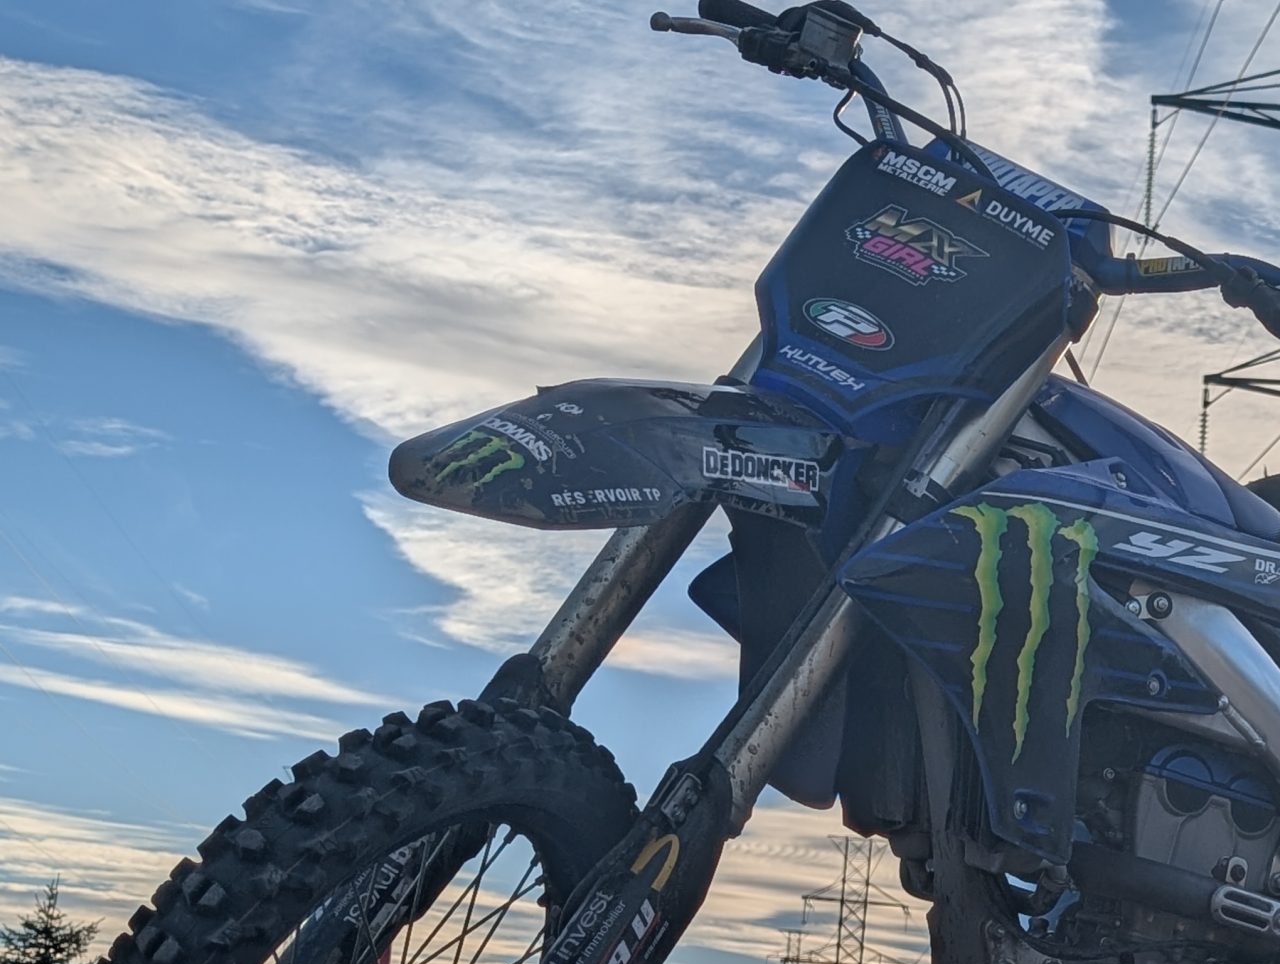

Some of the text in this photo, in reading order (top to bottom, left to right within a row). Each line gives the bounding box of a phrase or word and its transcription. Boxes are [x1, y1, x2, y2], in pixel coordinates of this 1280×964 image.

[877, 162, 950, 197] METALLERIE
[882, 151, 957, 190] MSCM
[985, 200, 1055, 247] DUYME
[862, 235, 936, 276] GIRL
[643, 487, 661, 502] TP
[1112, 531, 1247, 574] YZ
[557, 889, 614, 961] invest
[583, 900, 627, 958] immobilier
